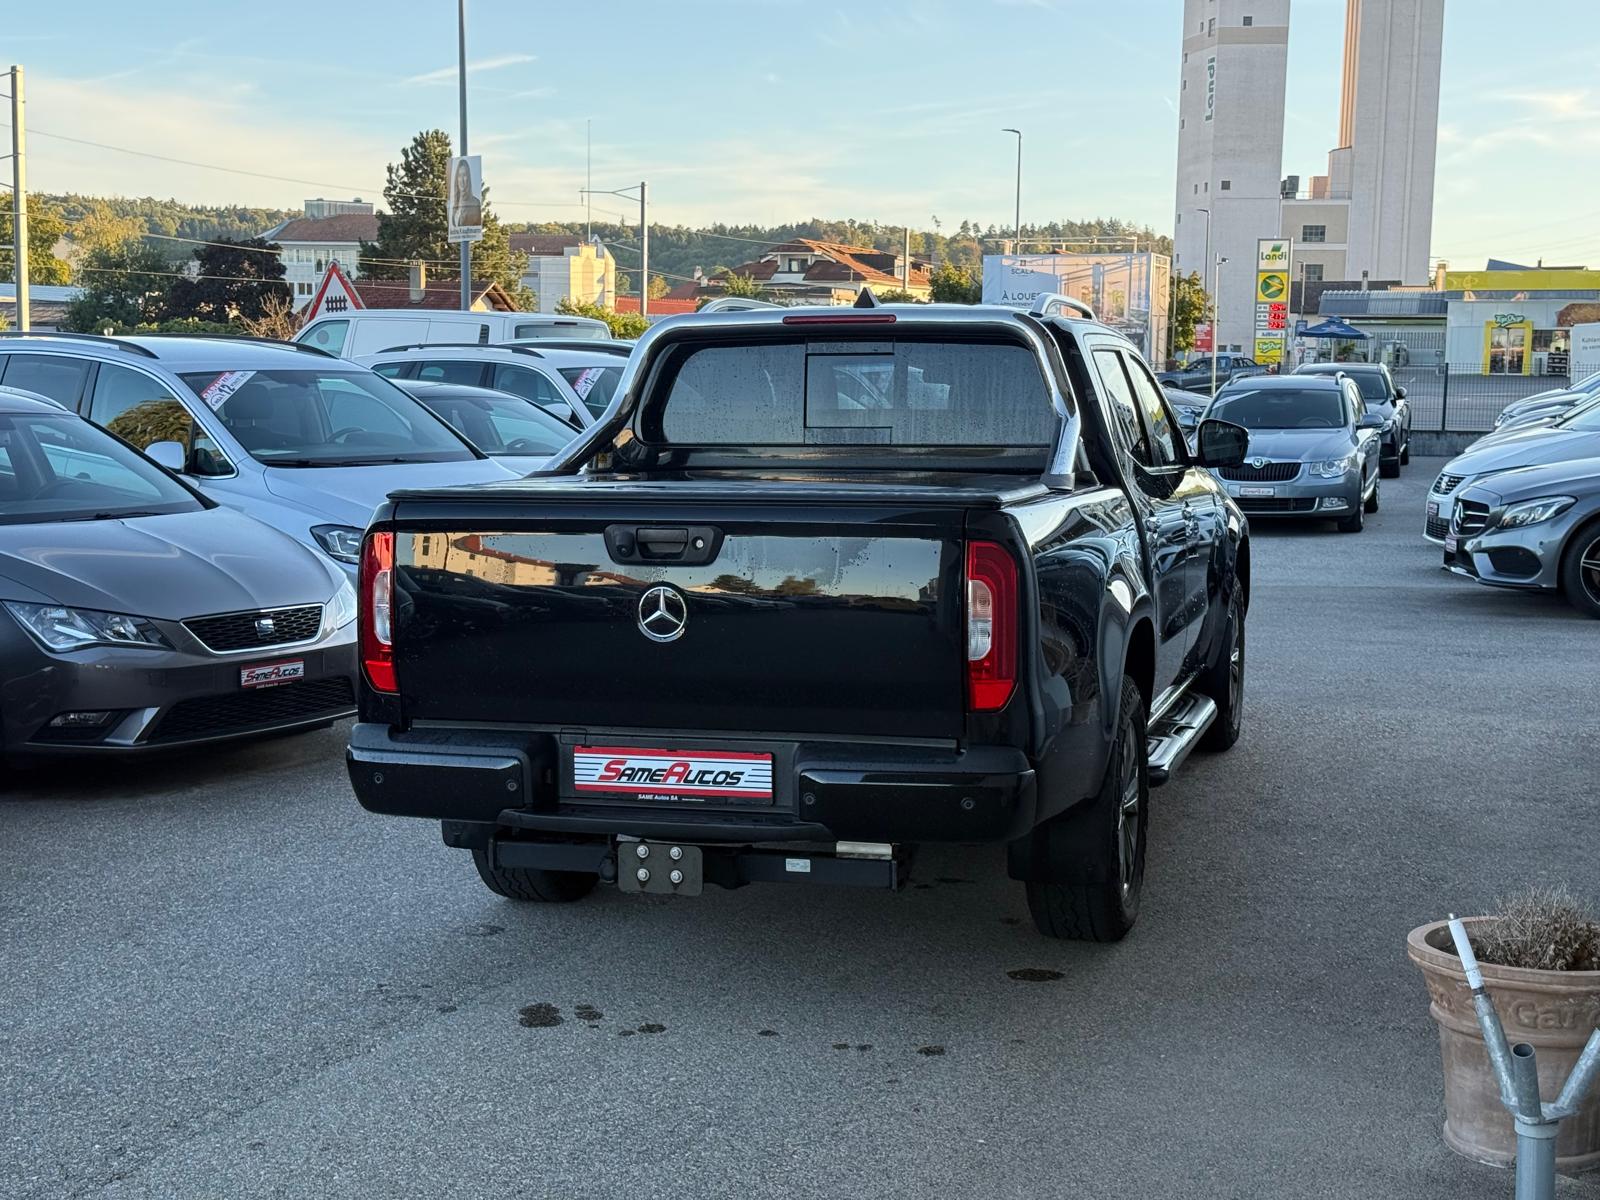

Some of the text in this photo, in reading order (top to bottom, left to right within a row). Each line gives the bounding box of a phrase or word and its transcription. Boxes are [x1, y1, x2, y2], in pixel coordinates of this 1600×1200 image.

[1205, 57, 1216, 122] Landi
[1261, 251, 1287, 261] Landi
[1001, 290, 1009, 300] À
[218, 384, 235, 395] 12
